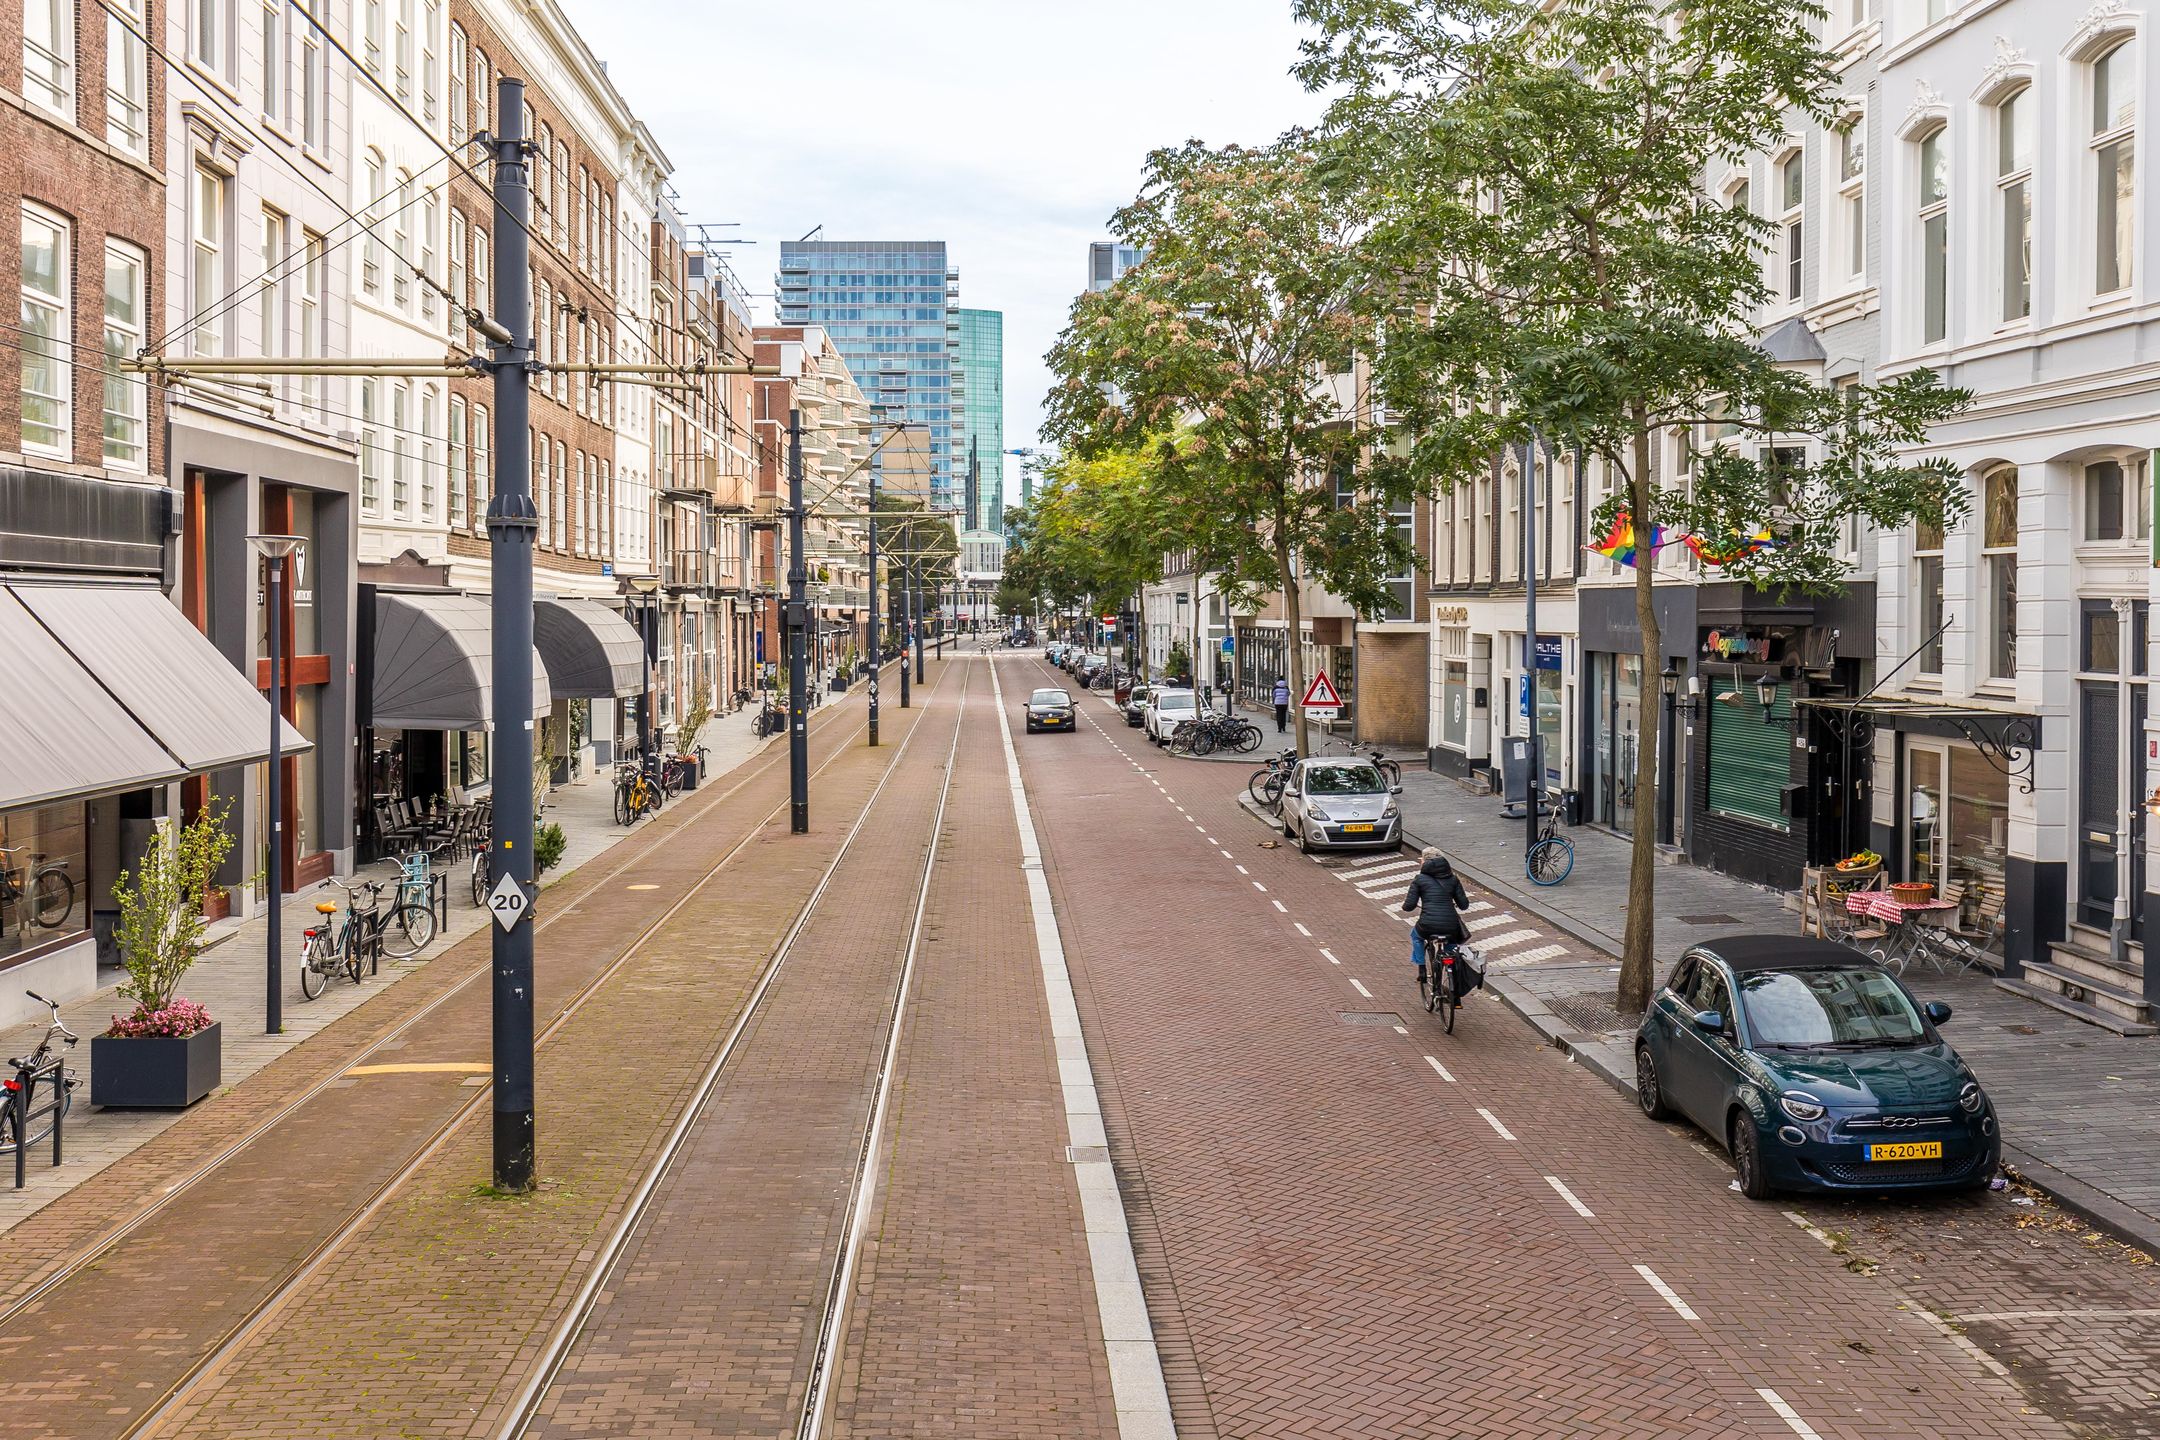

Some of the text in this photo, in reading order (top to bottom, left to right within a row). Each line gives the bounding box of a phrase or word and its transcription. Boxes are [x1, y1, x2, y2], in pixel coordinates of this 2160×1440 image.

[1708, 631, 1770, 661] Regenboog
[1521, 677, 1527, 698] P
[494, 894, 522, 910] 20
[1882, 1116, 1919, 1128] 500
[1875, 1144, 1938, 1158] R-620-VH
